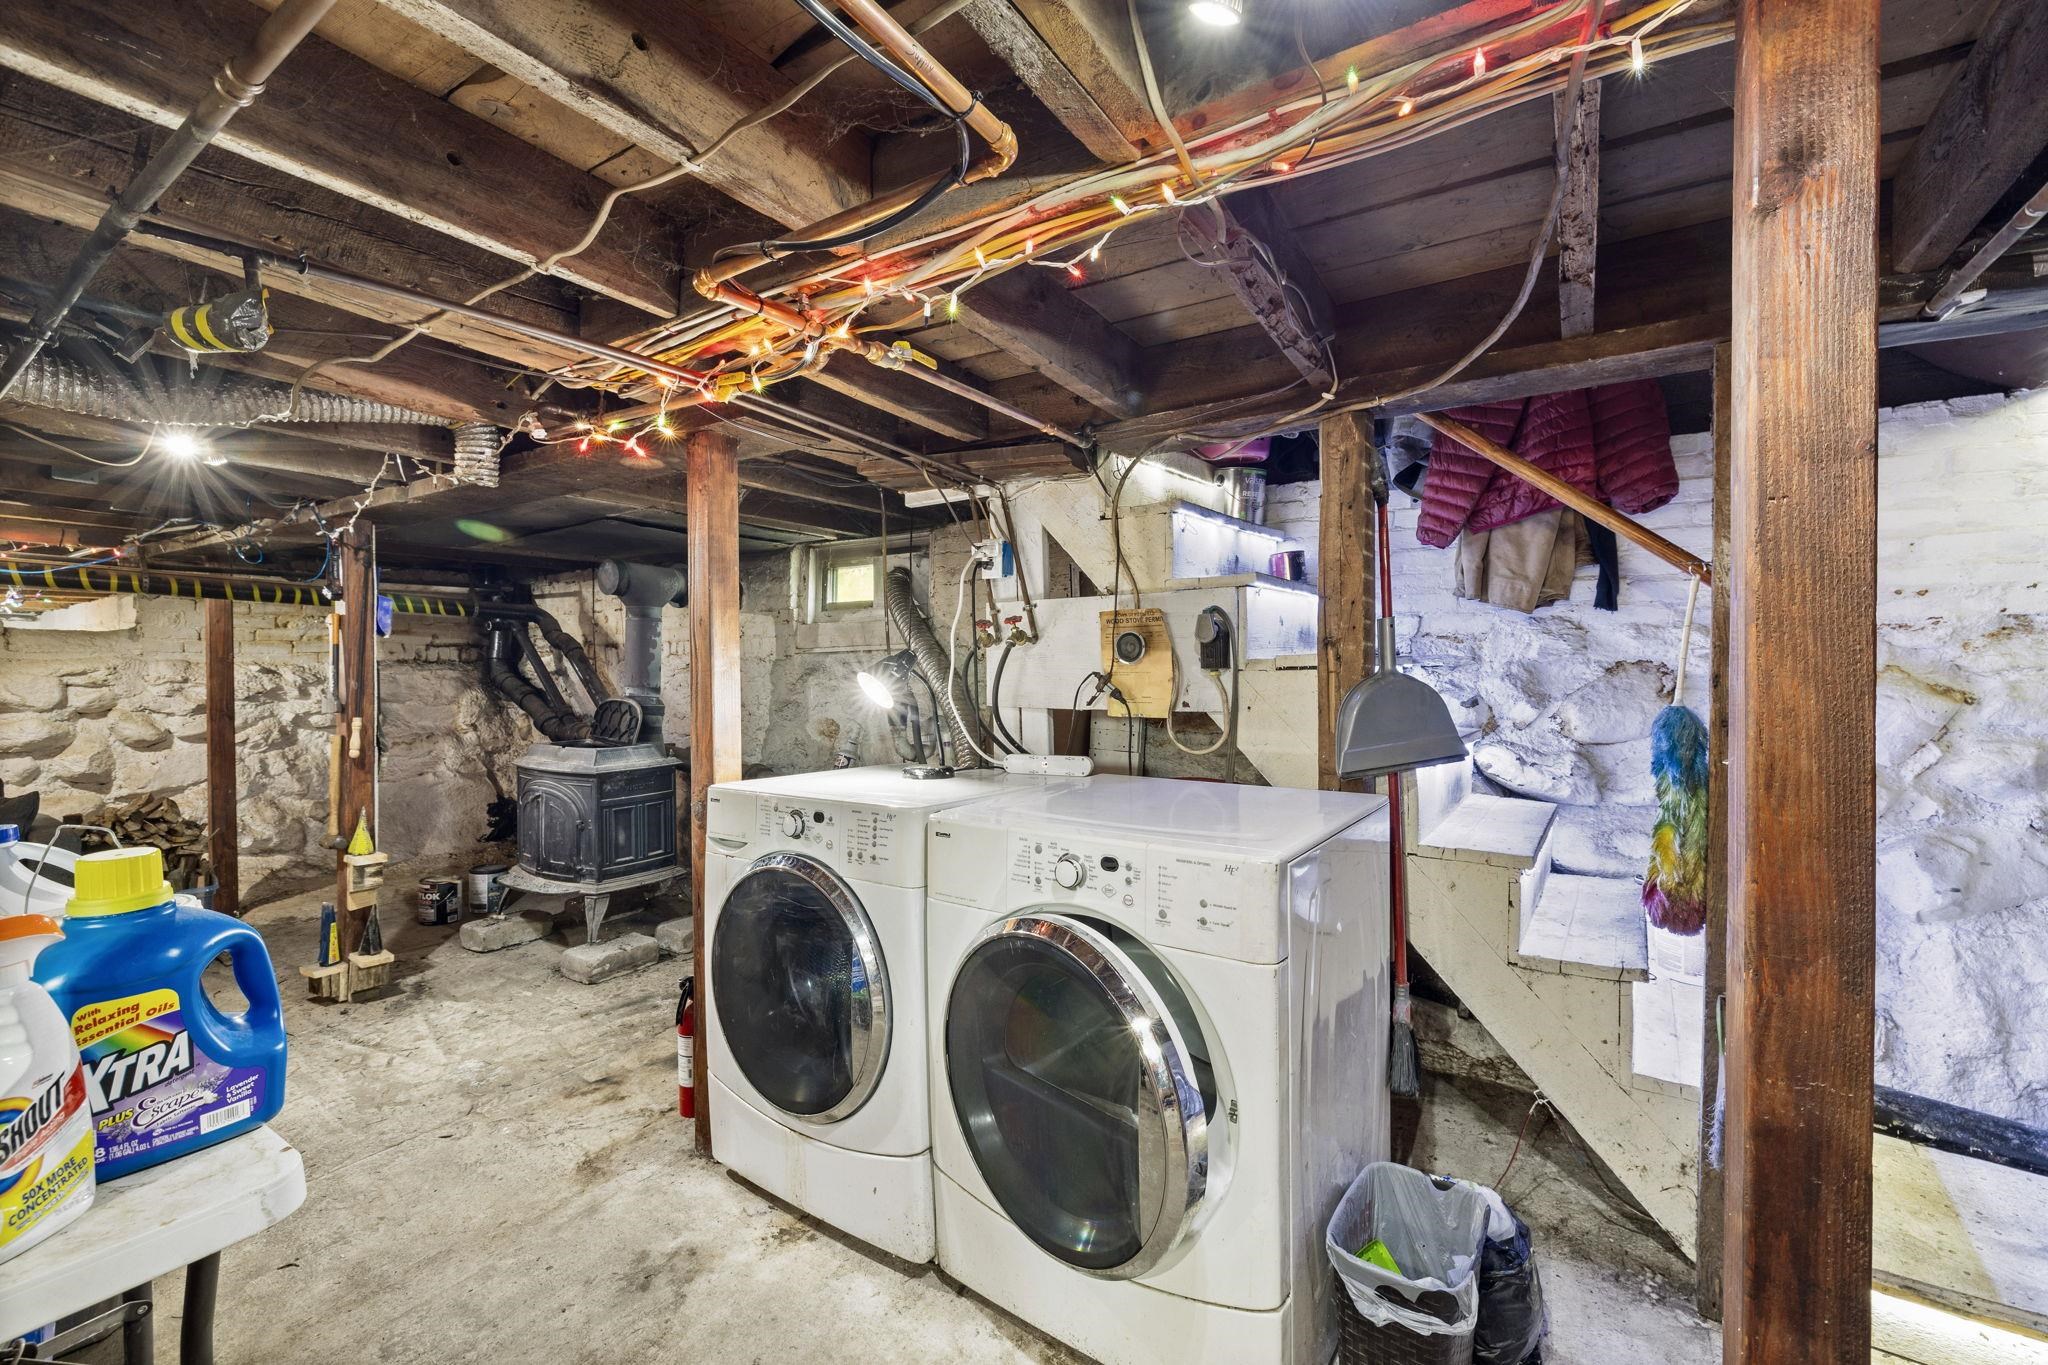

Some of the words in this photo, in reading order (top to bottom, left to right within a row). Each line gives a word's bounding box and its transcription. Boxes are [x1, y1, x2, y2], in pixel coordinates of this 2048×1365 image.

[74, 1003, 140, 1035] Relaxing
[76, 1007, 102, 1022] With
[76, 1013, 140, 1047] Essential
[145, 1001, 175, 1017] Oils
[83, 1030, 192, 1113] XTRA
[226, 1074, 259, 1093] Lavender
[227, 1089, 252, 1104] Vanilla
[232, 1081, 255, 1098] Sweet
[98, 1108, 134, 1131] PLUS
[131, 1089, 204, 1128] Escape
[8, 1157, 88, 1227] CONCENTRATED
[22, 1182, 44, 1205] 50X
[46, 1156, 77, 1186] MORE
